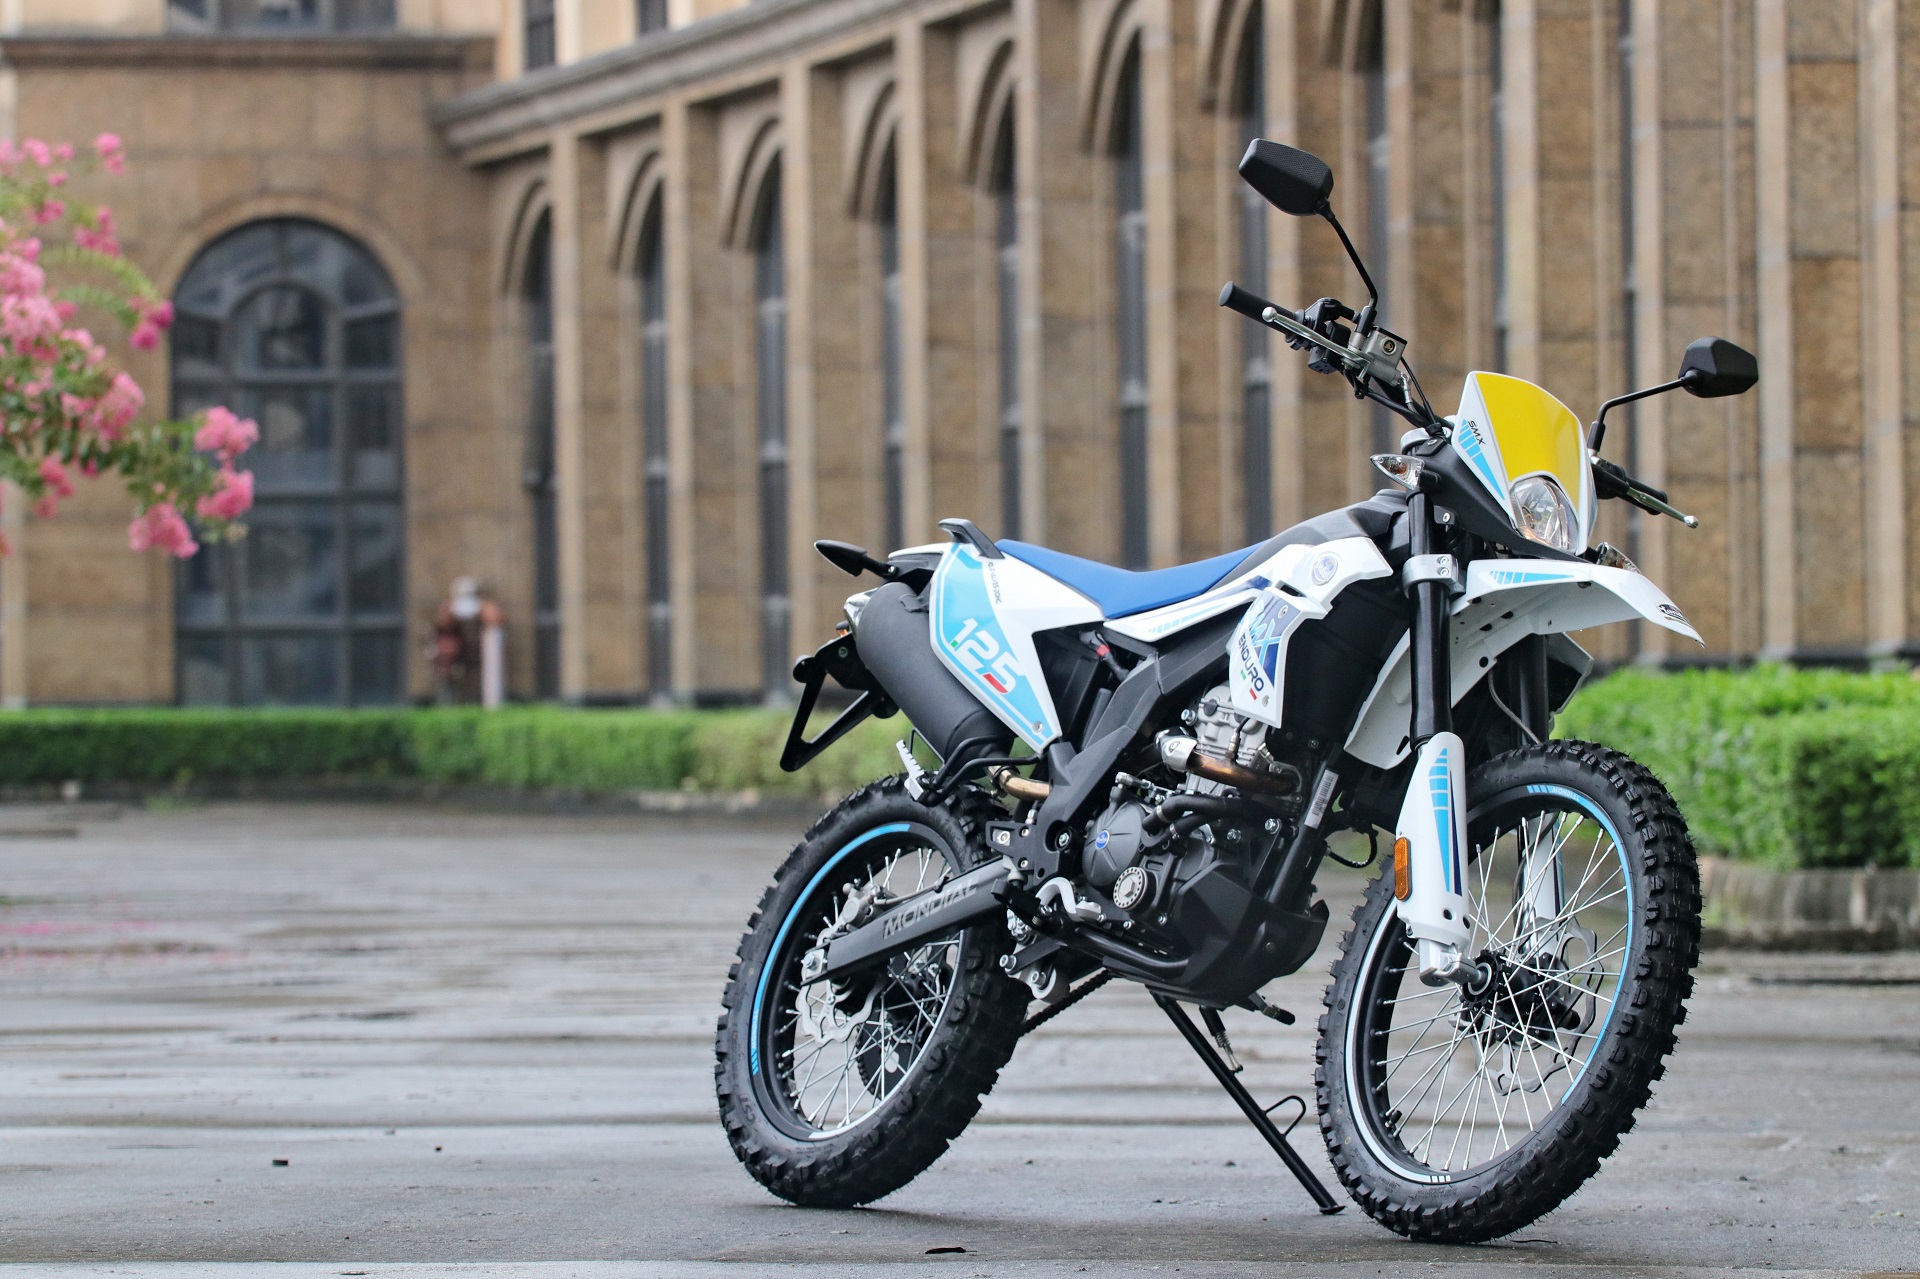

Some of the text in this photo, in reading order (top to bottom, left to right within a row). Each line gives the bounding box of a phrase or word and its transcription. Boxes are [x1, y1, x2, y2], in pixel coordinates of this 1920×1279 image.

[1466, 420, 1486, 445] SMX
[950, 617, 1026, 695] 125
[1238, 632, 1265, 692] ENDURO
[1551, 786, 1580, 801] MONDIAL
[883, 878, 979, 939] MONDIAL
